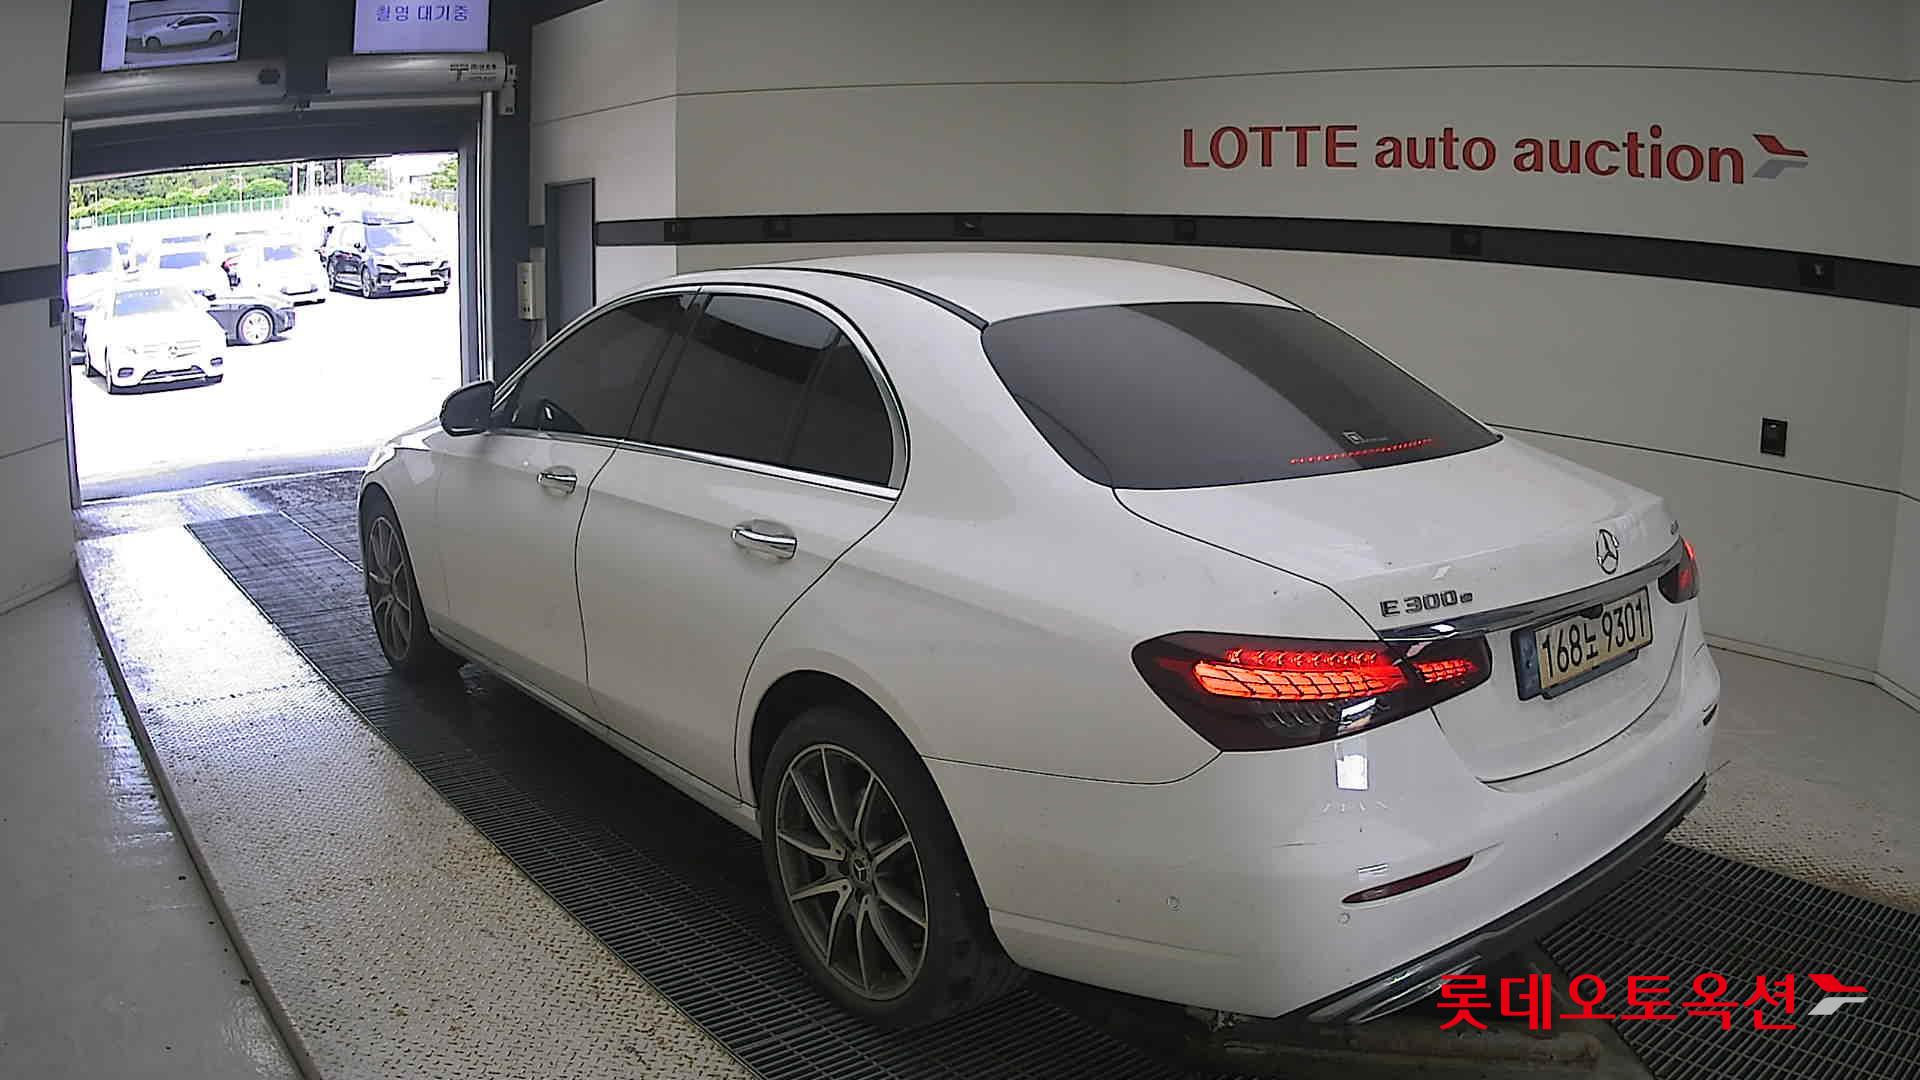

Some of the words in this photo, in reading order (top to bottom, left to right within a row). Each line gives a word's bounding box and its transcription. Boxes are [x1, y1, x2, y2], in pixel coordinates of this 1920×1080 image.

[417, 5, 468, 21] 대기중
[1183, 125, 1359, 168] LOTTE
[1375, 126, 1497, 171] auto
[1512, 125, 1745, 184] auction
[1601, 597, 1645, 653] 9301
